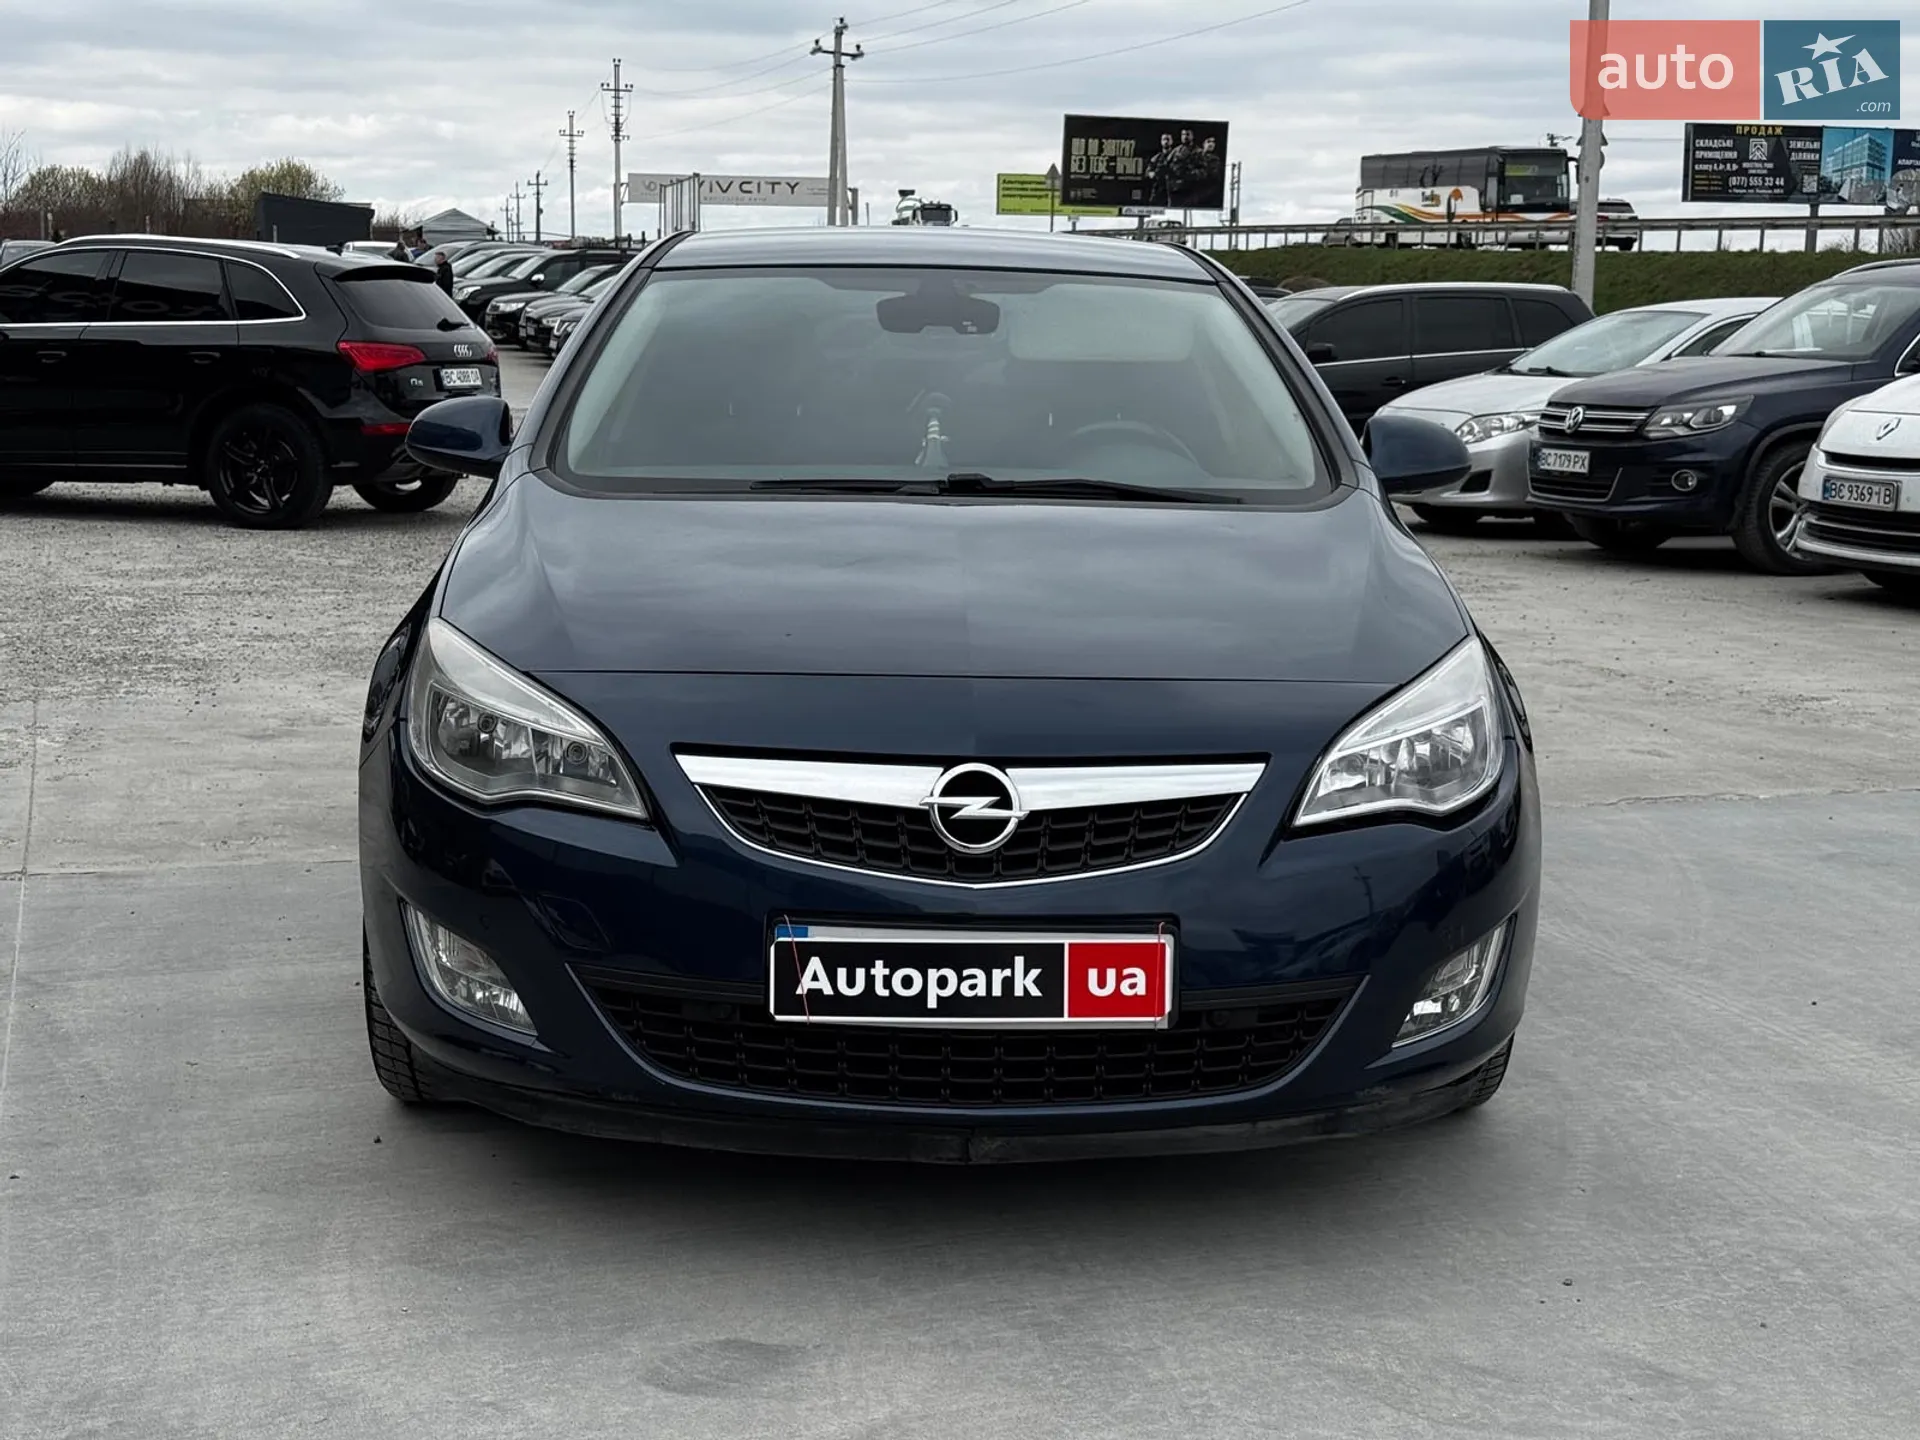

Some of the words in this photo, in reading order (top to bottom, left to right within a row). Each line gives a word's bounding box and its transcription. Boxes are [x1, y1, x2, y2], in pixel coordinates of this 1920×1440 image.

[1736, 125, 1783, 136] ПРОДАЖ
[1695, 139, 1733, 148] СКЛАДСЬКІ
[1789, 140, 1820, 149] ЗЕМЕЛЬНІ
[1790, 152, 1820, 161] ДІЛЯНКИ
[1728, 176, 1747, 187] (077)
[1749, 176, 1763, 186] 555
[1775, 177, 1784, 186] 44
[1573, 454, 1587, 469] PX
[1847, 484, 1873, 502] 9369
[795, 955, 1043, 1009] Autopark
[1087, 967, 1147, 997] ua
